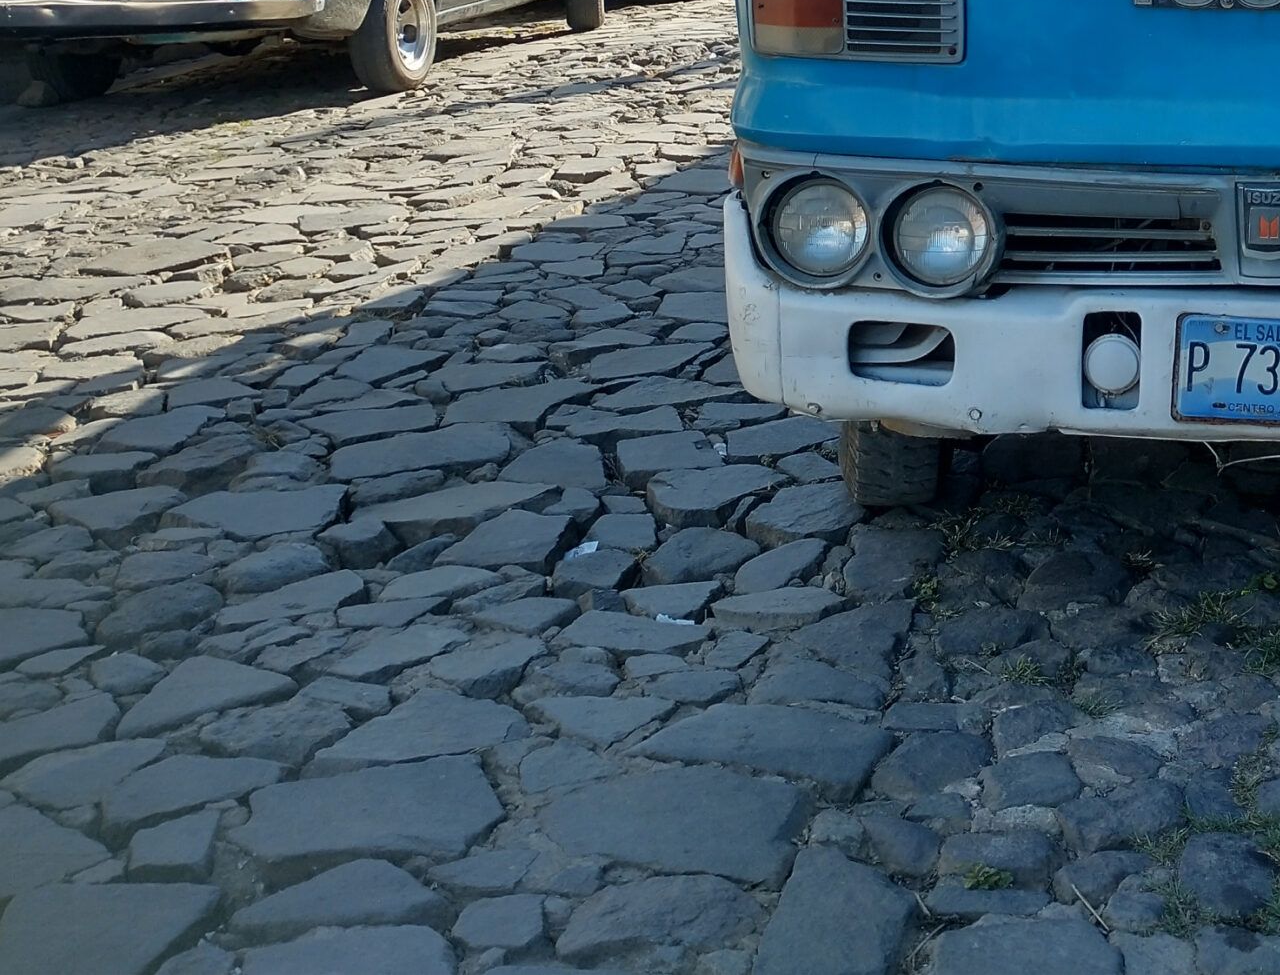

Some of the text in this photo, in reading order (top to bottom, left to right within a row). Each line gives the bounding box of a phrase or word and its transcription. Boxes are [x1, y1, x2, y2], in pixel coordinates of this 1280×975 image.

[1234, 323, 1251, 341] EL
[1186, 341, 1210, 392] P
[1234, 343, 1280, 396] 73
[1227, 402, 1275, 415] CENTRO
